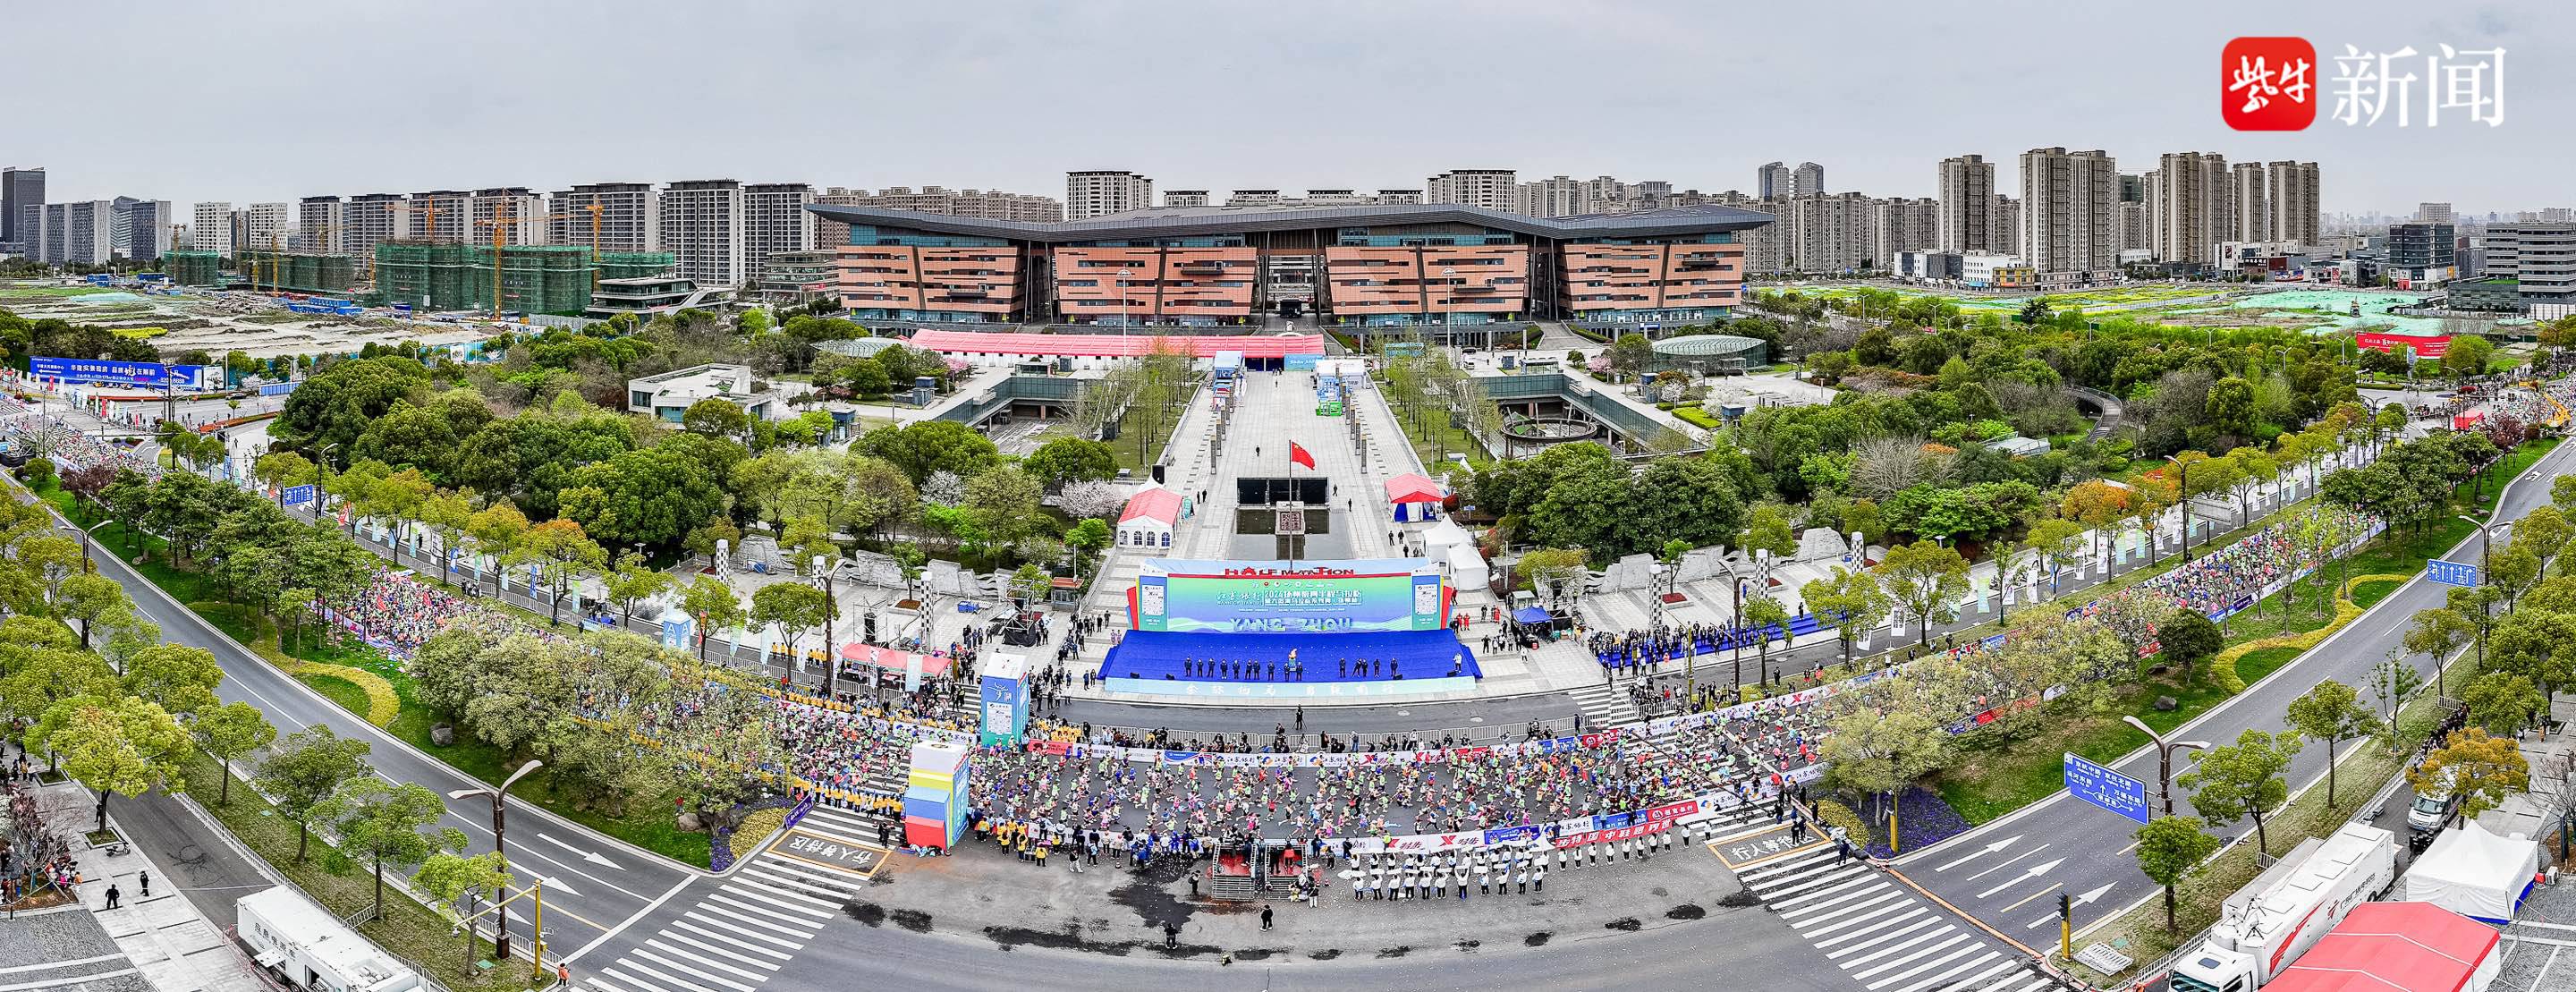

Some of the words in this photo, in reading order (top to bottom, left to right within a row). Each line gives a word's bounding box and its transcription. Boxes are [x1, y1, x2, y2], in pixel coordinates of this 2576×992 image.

[1230, 617, 1286, 632] YANG
[1300, 617, 1352, 632] ZHOU
[789, 835, 873, 865] 行人等待区
